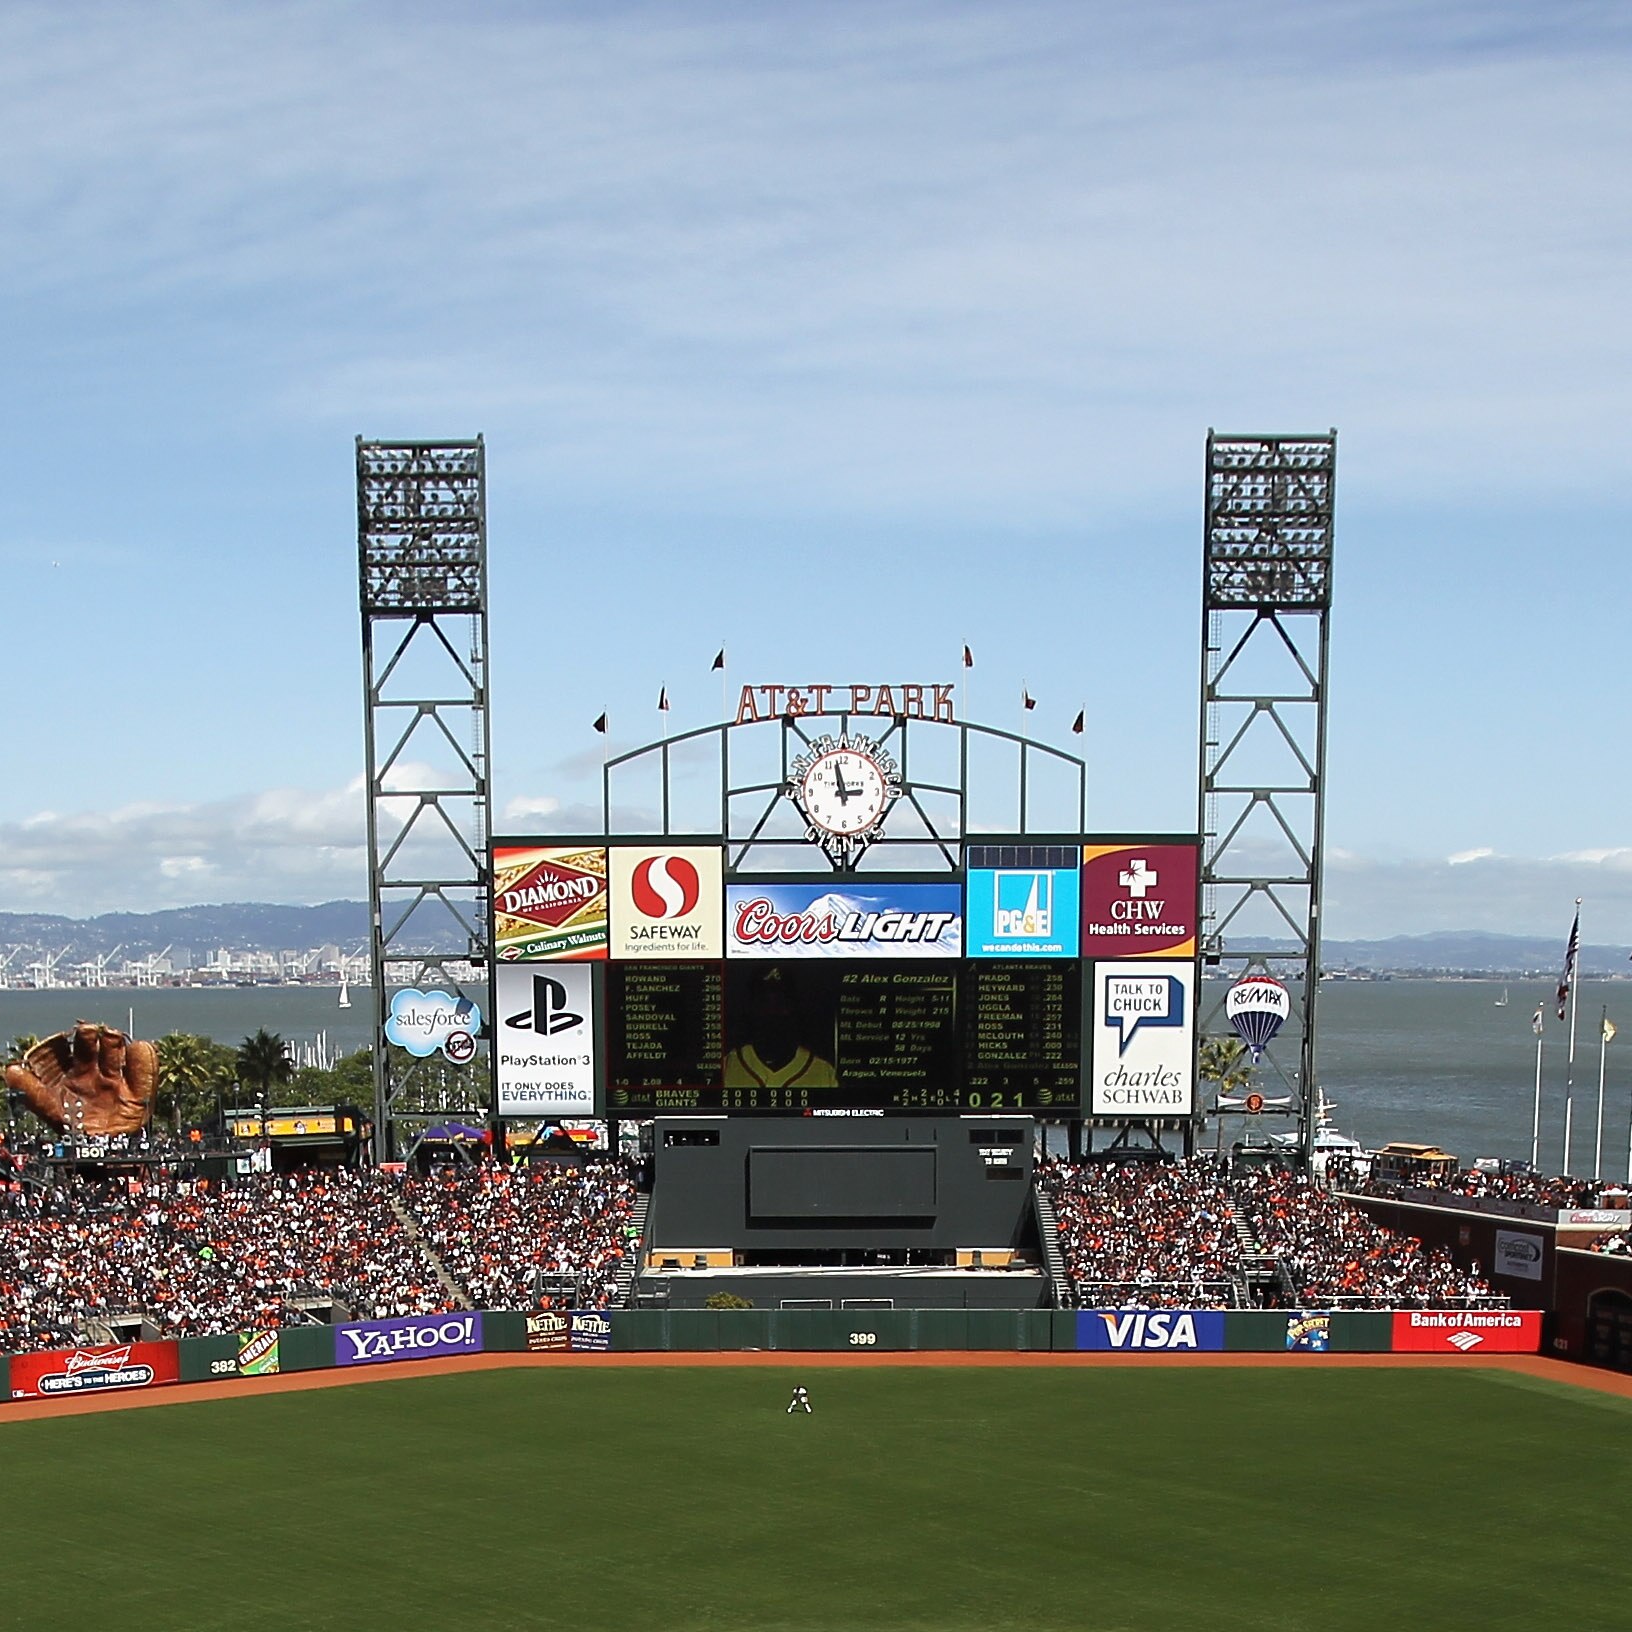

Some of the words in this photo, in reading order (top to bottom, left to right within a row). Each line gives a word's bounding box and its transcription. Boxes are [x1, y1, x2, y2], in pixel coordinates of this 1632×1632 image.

[735, 685, 831, 725] AT&T
[849, 684, 954, 723] PARK
[785, 756, 811, 800] SAN
[809, 732, 903, 799] FRANCISCO
[804, 823, 885, 852] GIANTS
[504, 876, 598, 913] DIAMOND
[1111, 900, 1165, 920] CHW
[734, 897, 839, 944] Coors
[839, 912, 955, 942] LIGHT
[998, 909, 1048, 934] PG&E
[630, 925, 702, 940] SAFEWAY
[1089, 923, 1131, 936] Health
[1134, 923, 1186, 936] Services
[526, 937, 567, 954] Culinary
[568, 930, 607, 946] Walnuts
[625, 942, 675, 954] Ingredients
[676, 942, 690, 951] for
[691, 942, 709, 951] life.
[982, 943, 1063, 953] wecandothis.com
[861, 974, 889, 984] Alex
[893, 974, 950, 984] Gonzalez
[978, 974, 1011, 982] PRADO
[978, 984, 1025, 992] HEYWARD
[1114, 984, 1143, 995] TALK
[1149, 984, 1163, 995] TO
[1233, 986, 1283, 1007] RE/MAX
[879, 1007, 887, 1015] R
[978, 1003, 1011, 1011] UGGLA
[1113, 998, 1162, 1011] CHUCK
[396, 1008, 471, 1034] salesforce
[626, 1013, 676, 1021] SANDOVAL
[895, 1033, 906, 1041] 12
[880, 1069, 927, 1077] Venezuela
[1104, 1064, 1181, 1087] charles
[502, 1082, 510, 1090] IT
[514, 1082, 541, 1090] ONLY
[545, 1082, 574, 1090] DOES
[656, 1090, 700, 1098] BRAVES
[969, 1092, 981, 1108] 0
[990, 1092, 1004, 1108] 2
[1013, 1092, 1023, 1108] 1
[1102, 1089, 1183, 1105] SCHWAB
[656, 1099, 697, 1107] GIANTS
[813, 1109, 851, 1117] MITSUBISHI
[851, 1109, 885, 1117] ELECTRIC
[76, 1147, 105, 1159] 1501
[526, 1312, 568, 1334] KETTLE
[571, 1314, 611, 1334] KETTLE
[1303, 1316, 1330, 1329] SECRET
[1411, 1313, 1444, 1327] Bank
[1445, 1314, 1463, 1327] of
[1463, 1313, 1522, 1327] America
[1097, 1313, 1197, 1348] VISA
[341, 1318, 476, 1361] YAHOO!
[849, 1333, 876, 1345] 399
[238, 1329, 279, 1366] EMERALD
[65, 1355, 130, 1372] Budweiser
[210, 1359, 236, 1374] 382
[44, 1375, 82, 1391] HERE'S
[103, 1370, 147, 1386] HEROES
